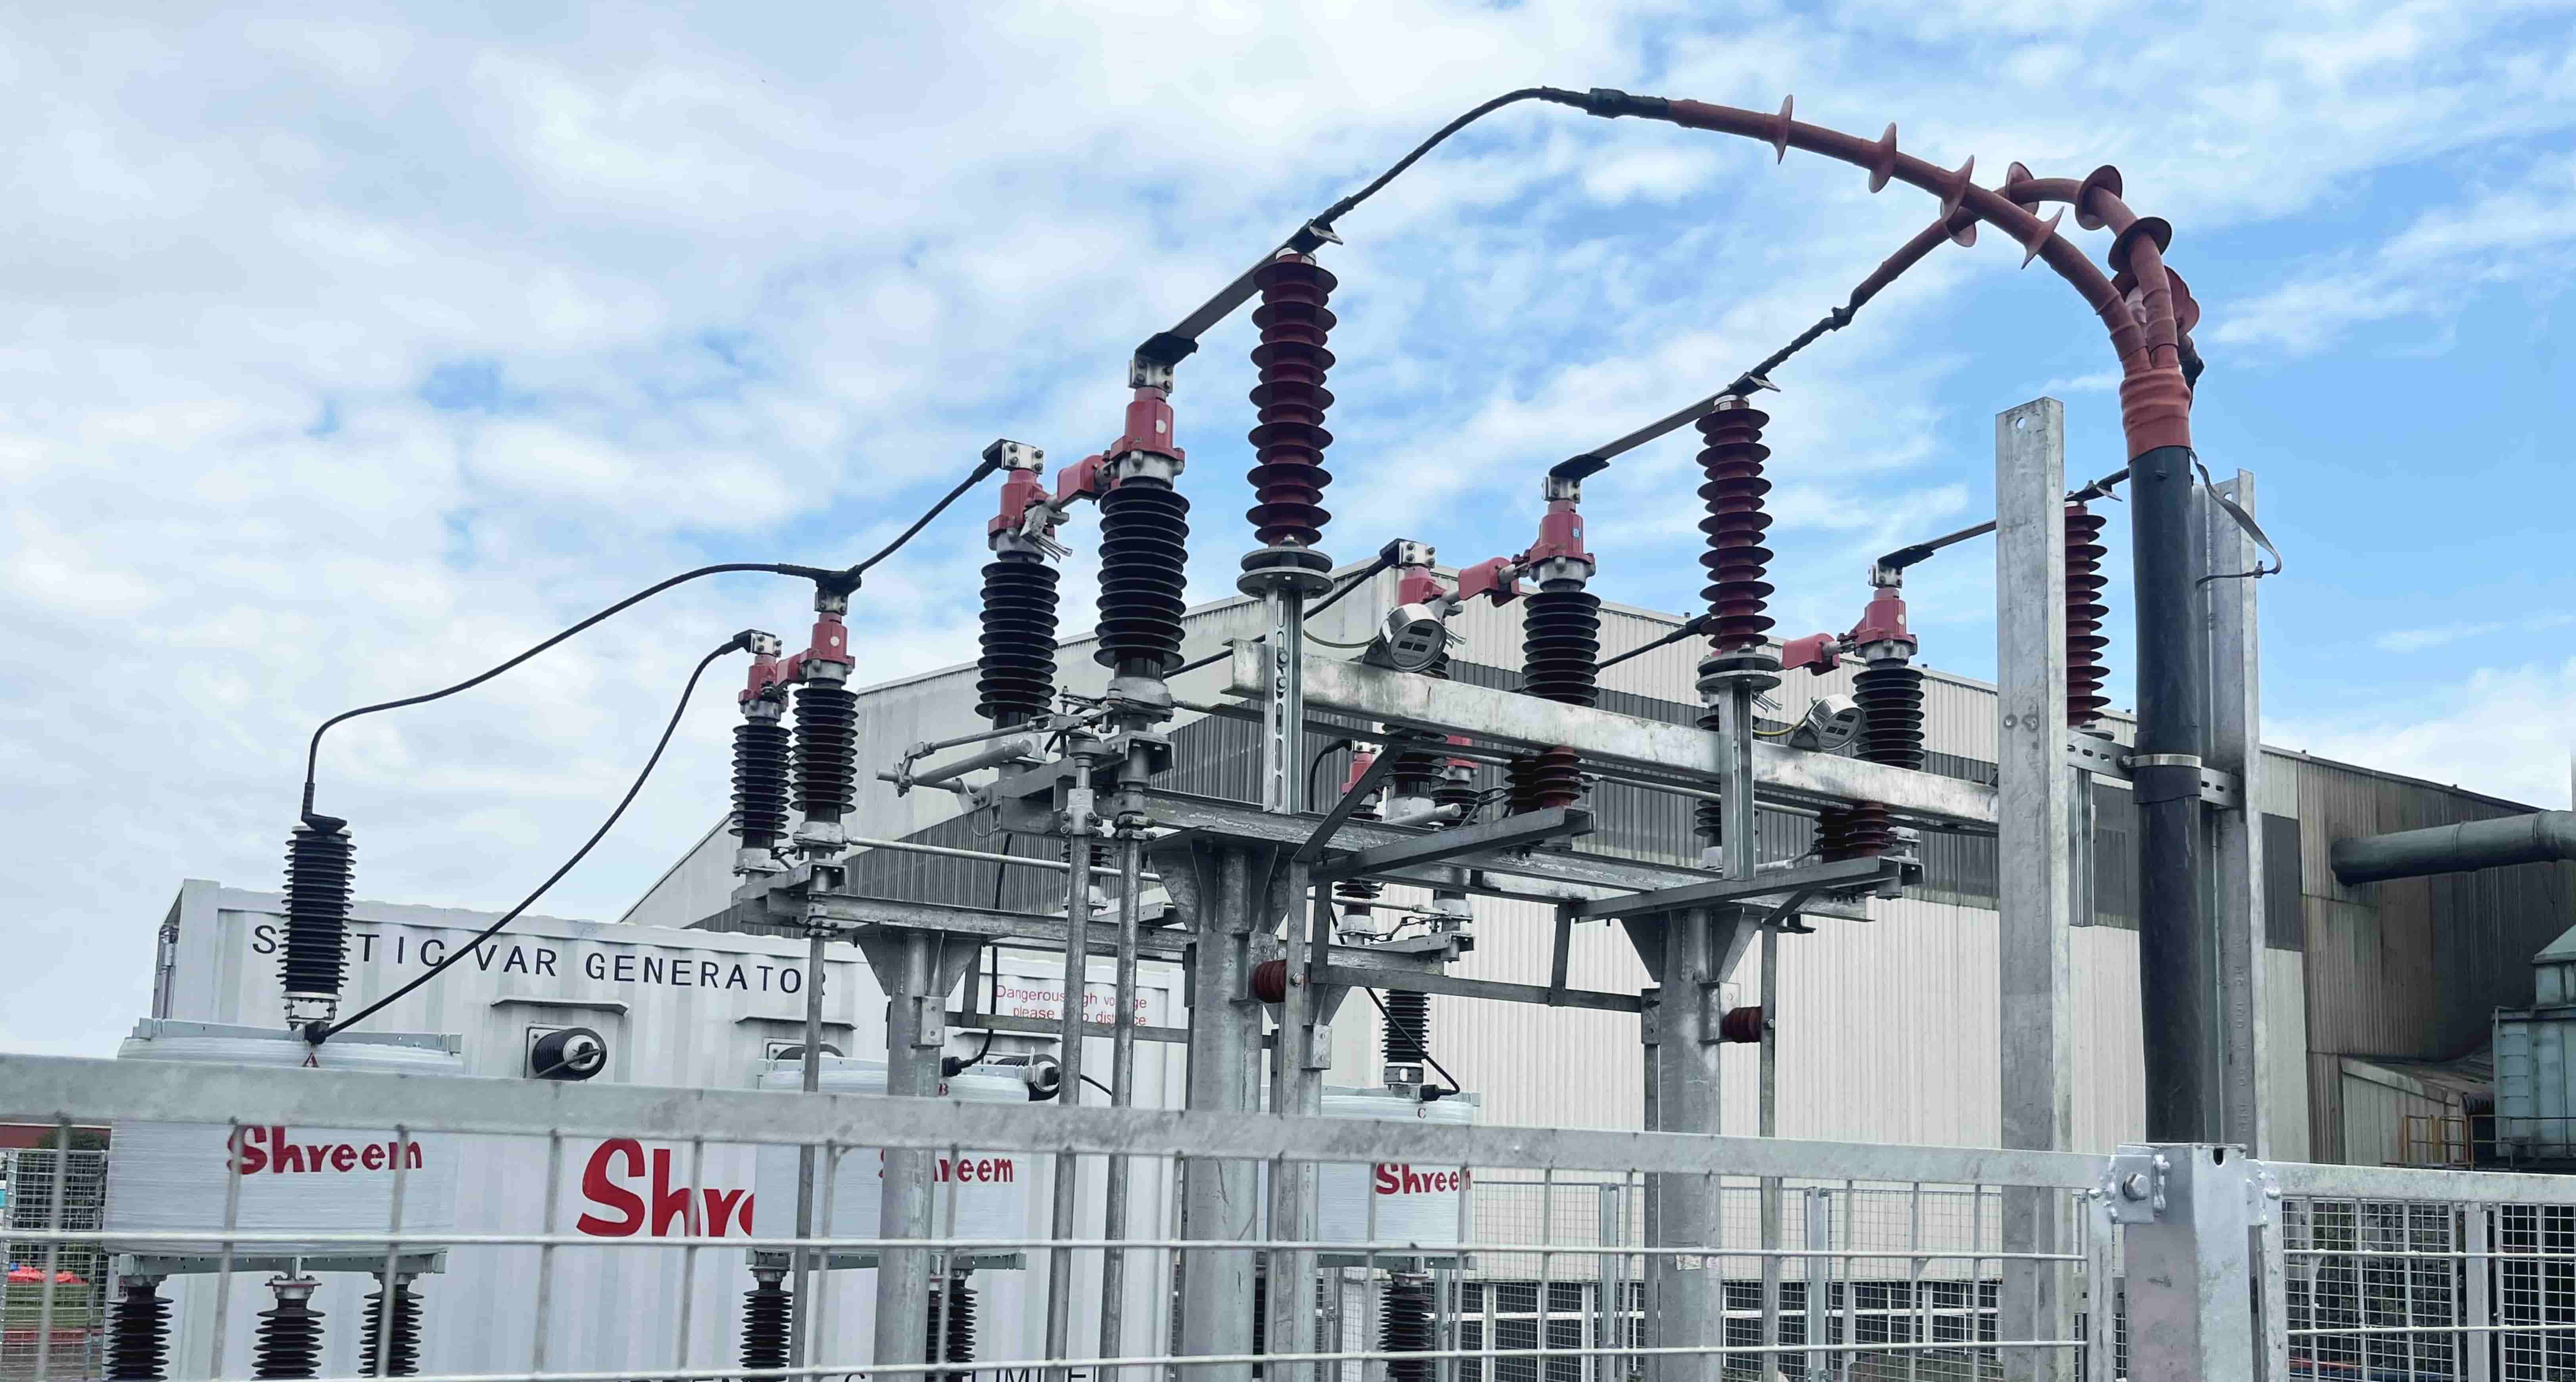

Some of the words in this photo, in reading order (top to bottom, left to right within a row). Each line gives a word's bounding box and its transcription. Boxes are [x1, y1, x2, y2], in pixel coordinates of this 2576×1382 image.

[252, 925, 445, 966] STIC
[475, 944, 556, 977] VAR
[585, 952, 826, 996] GENERATO
[878, 1149, 1014, 1182] reem
